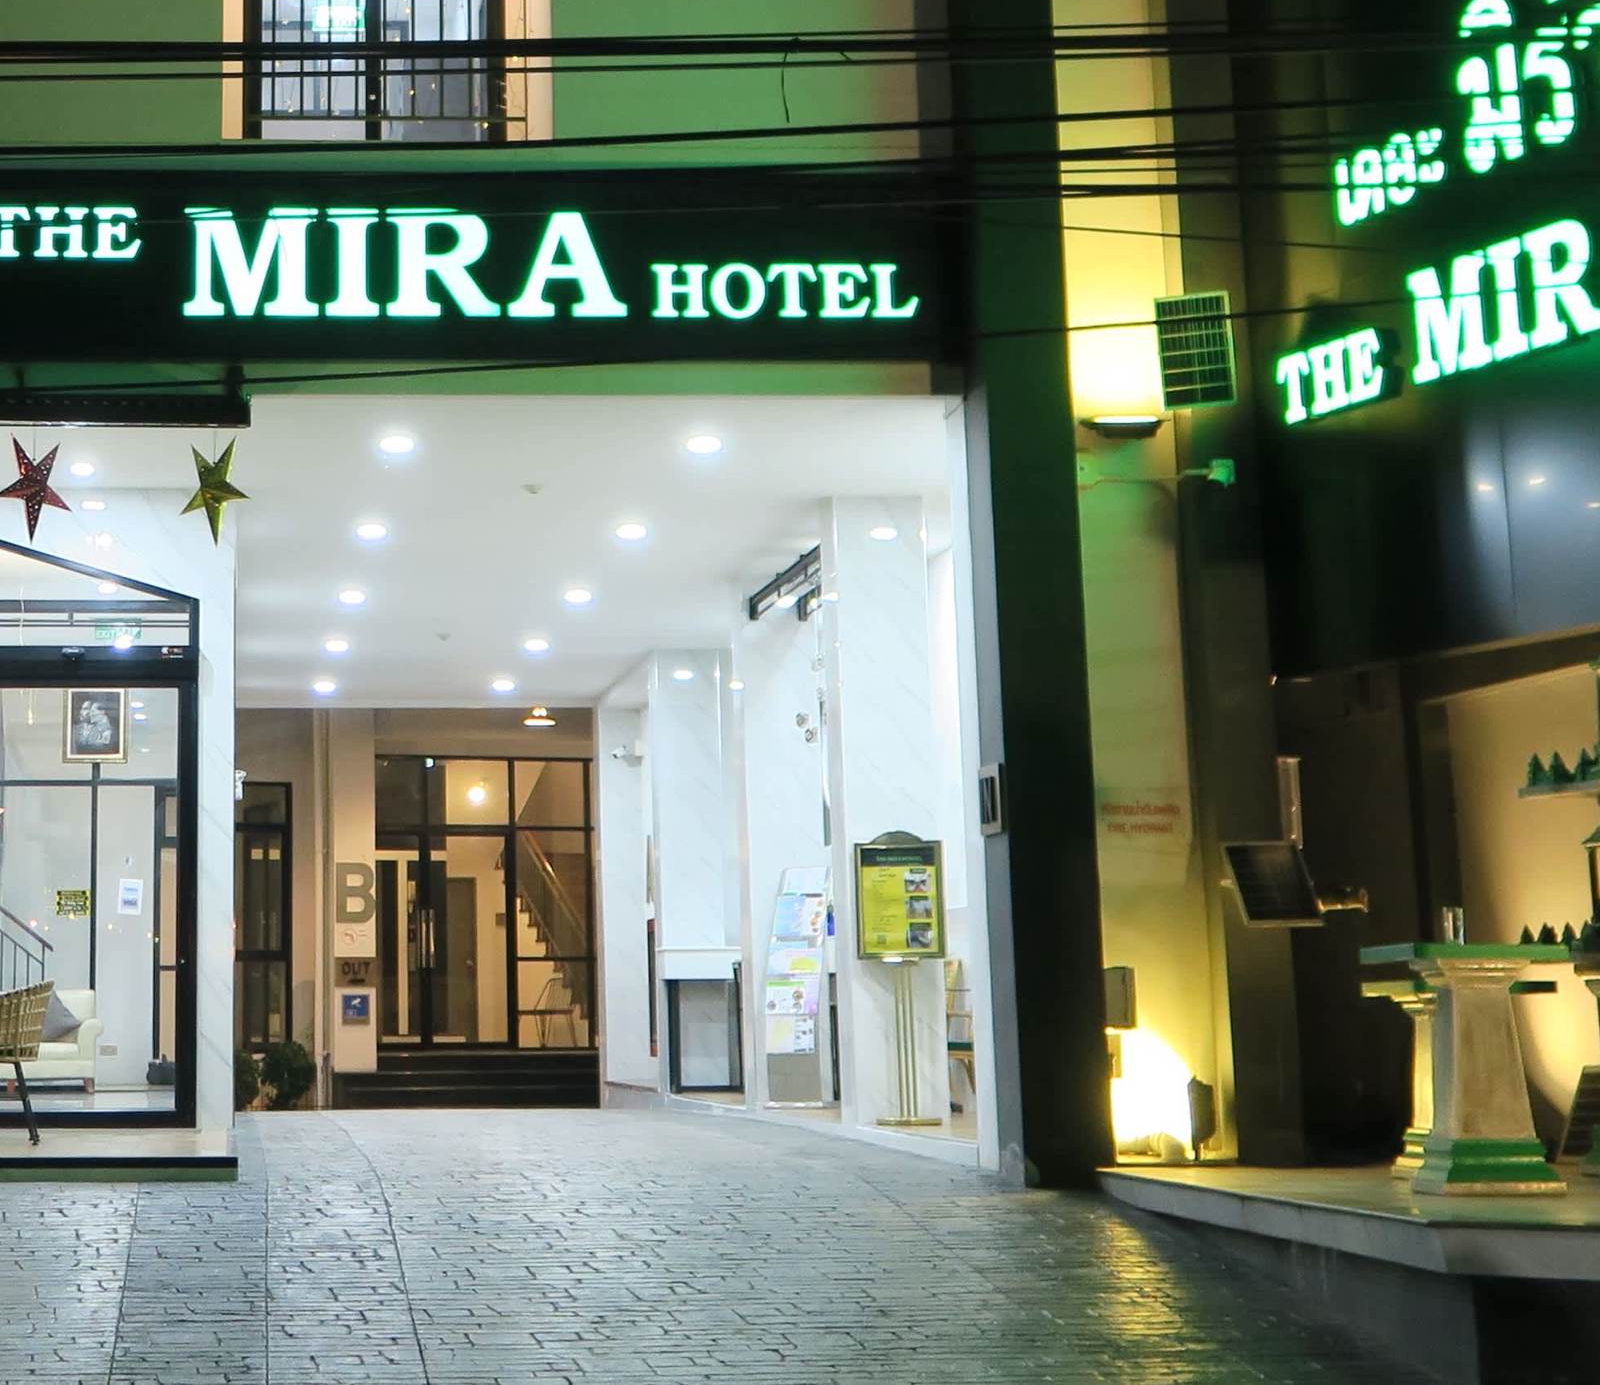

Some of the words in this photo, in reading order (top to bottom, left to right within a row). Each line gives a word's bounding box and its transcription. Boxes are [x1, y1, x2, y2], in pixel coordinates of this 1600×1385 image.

[0, 206, 142, 259] THE
[183, 208, 627, 317] MIRA
[651, 263, 918, 319] HOTEL
[1276, 328, 1383, 424] THE
[1407, 219, 1600, 384] MIR
[336, 862, 376, 923] B
